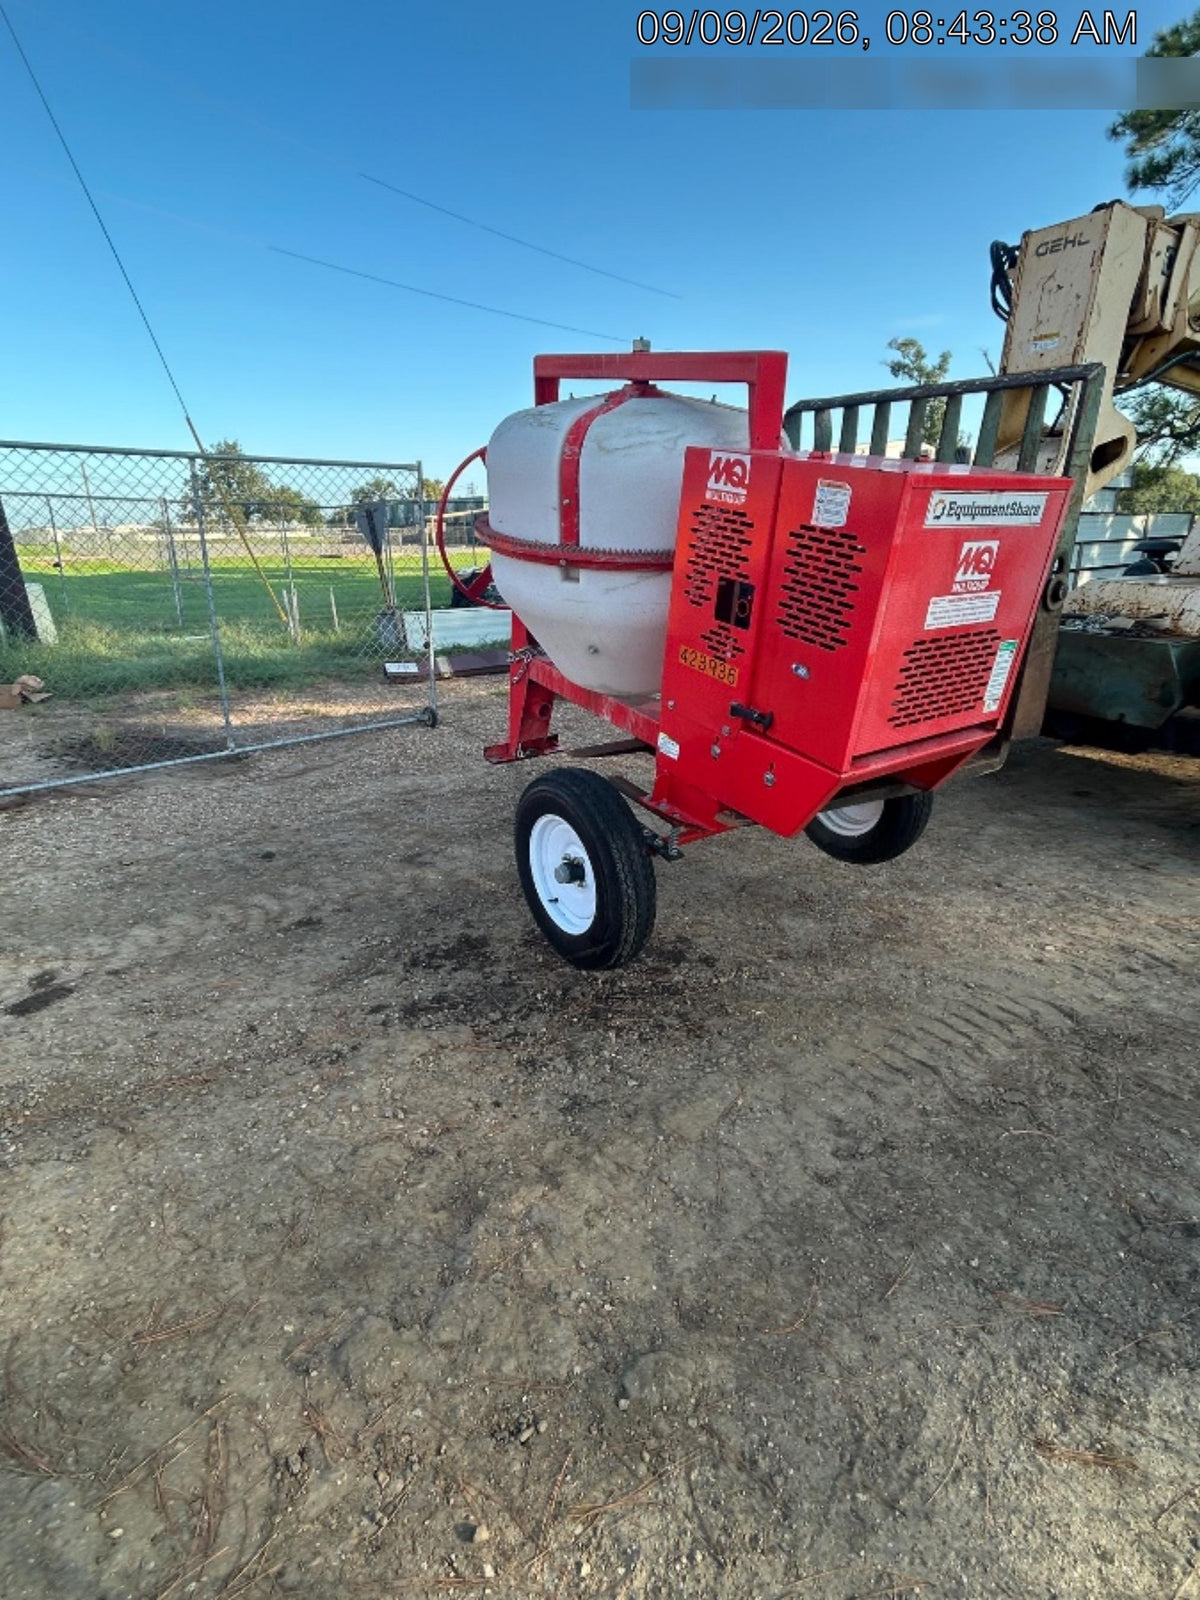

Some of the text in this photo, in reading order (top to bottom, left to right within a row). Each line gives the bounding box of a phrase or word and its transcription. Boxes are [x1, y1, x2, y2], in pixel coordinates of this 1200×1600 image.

[1035, 233, 1090, 257] GEHL
[710, 456, 748, 488] MQ
[946, 501, 1041, 520] EquipmentShare
[679, 648, 737, 686] 423936
